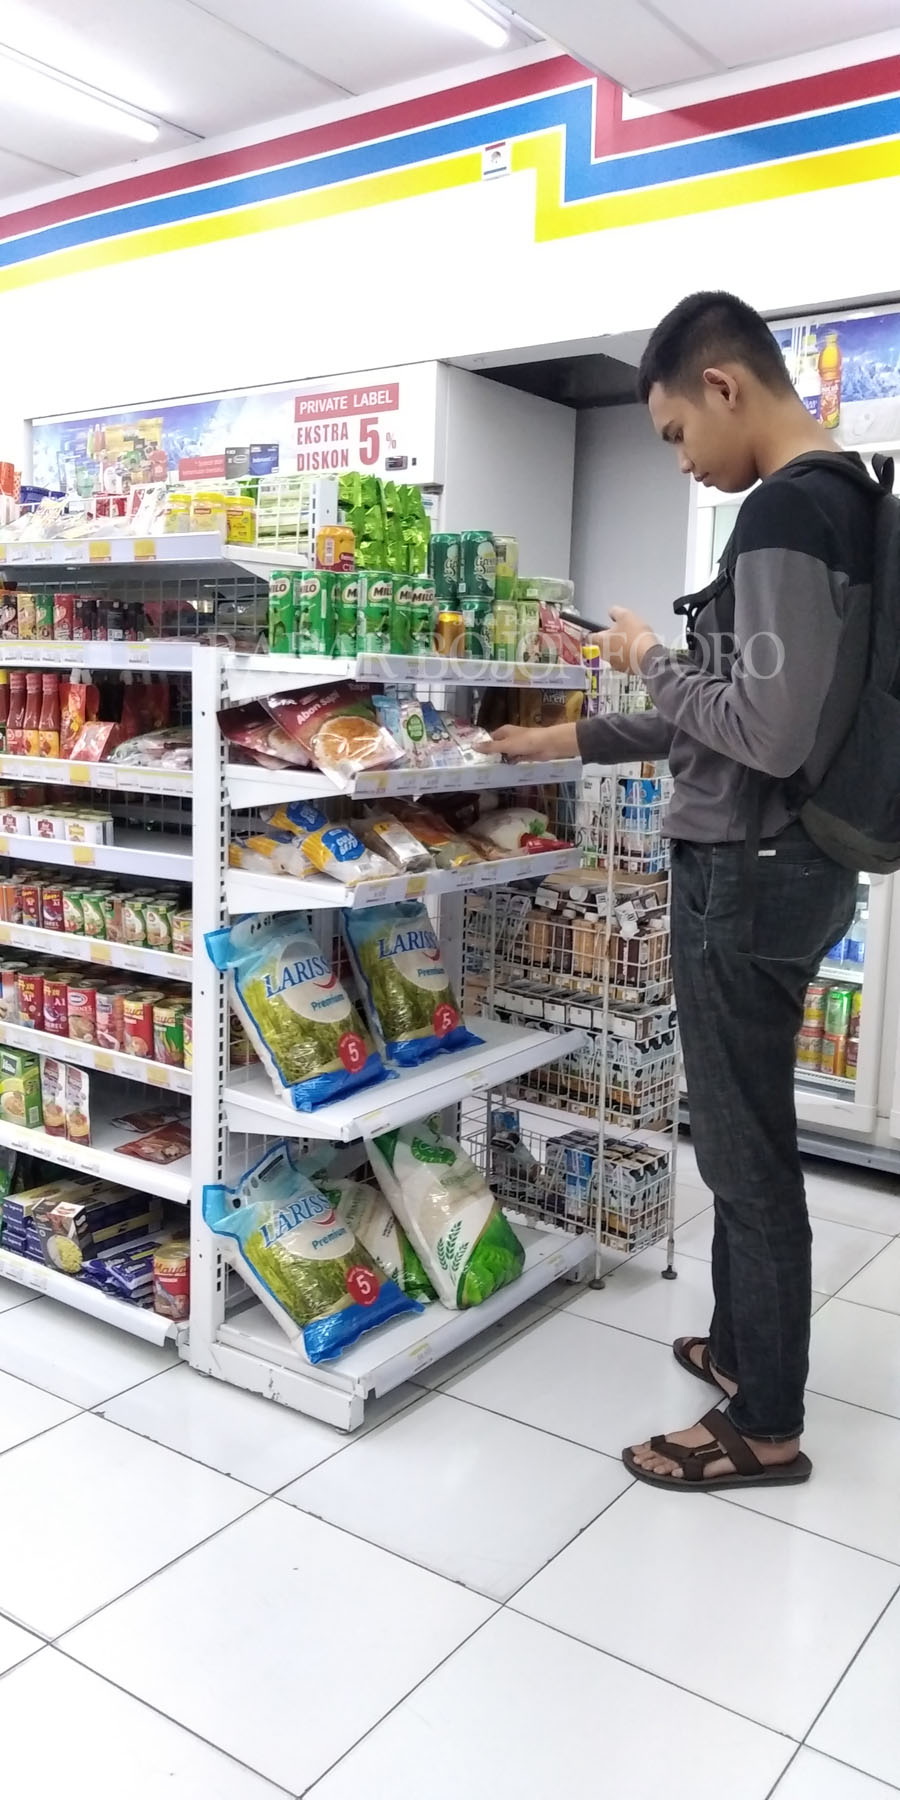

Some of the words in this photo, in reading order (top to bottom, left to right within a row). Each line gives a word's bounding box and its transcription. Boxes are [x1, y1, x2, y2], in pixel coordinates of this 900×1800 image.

[299, 395, 348, 415] PRIVATE
[353, 389, 393, 408] LABEL
[297, 421, 349, 445] EKSTRA
[297, 448, 349, 471] DISKON
[296, 703, 321, 725] Abon
[442, 1011, 453, 1030] 5
[348, 1041, 360, 1063] 5
[356, 1274, 372, 1295] 5
